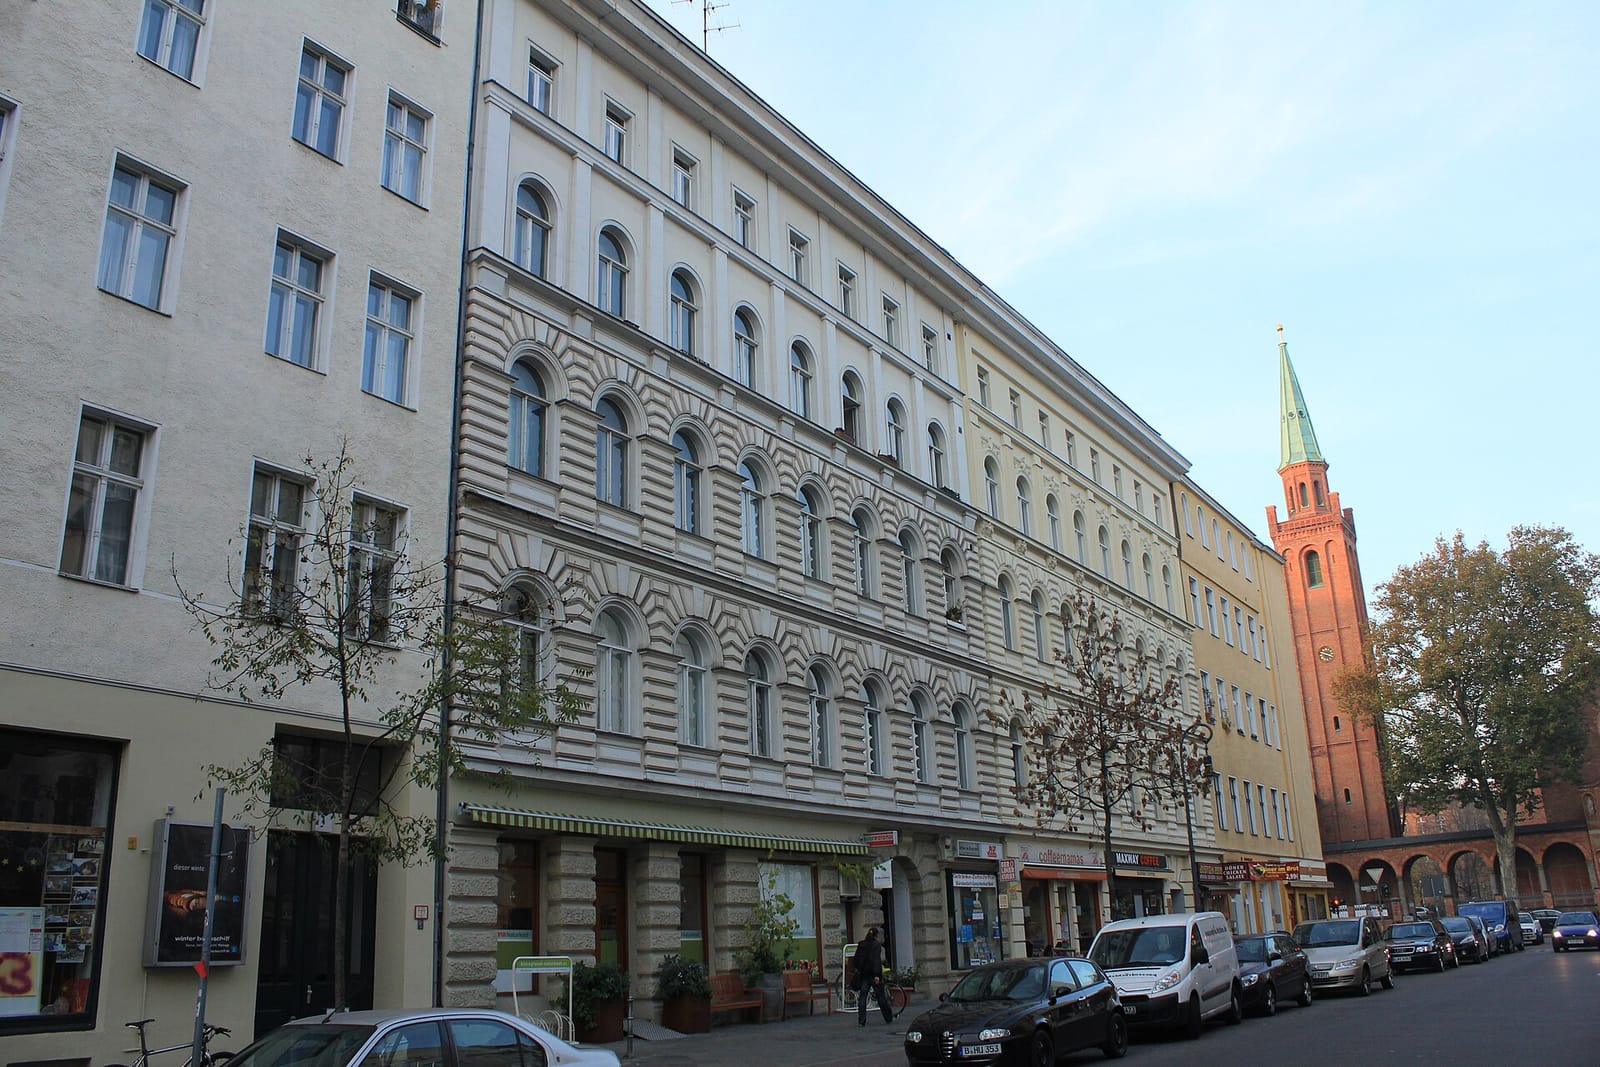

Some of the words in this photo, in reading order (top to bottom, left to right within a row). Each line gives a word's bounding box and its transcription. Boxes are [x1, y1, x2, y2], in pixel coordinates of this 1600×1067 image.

[1039, 849, 1085, 865] coffeemamas
[1116, 852, 1139, 865] MAXWAY
[1140, 855, 1160, 867] COFFEE
[964, 1047, 970, 1055] B
[973, 1046, 984, 1054] HU
[985, 1045, 999, 1053] 353
